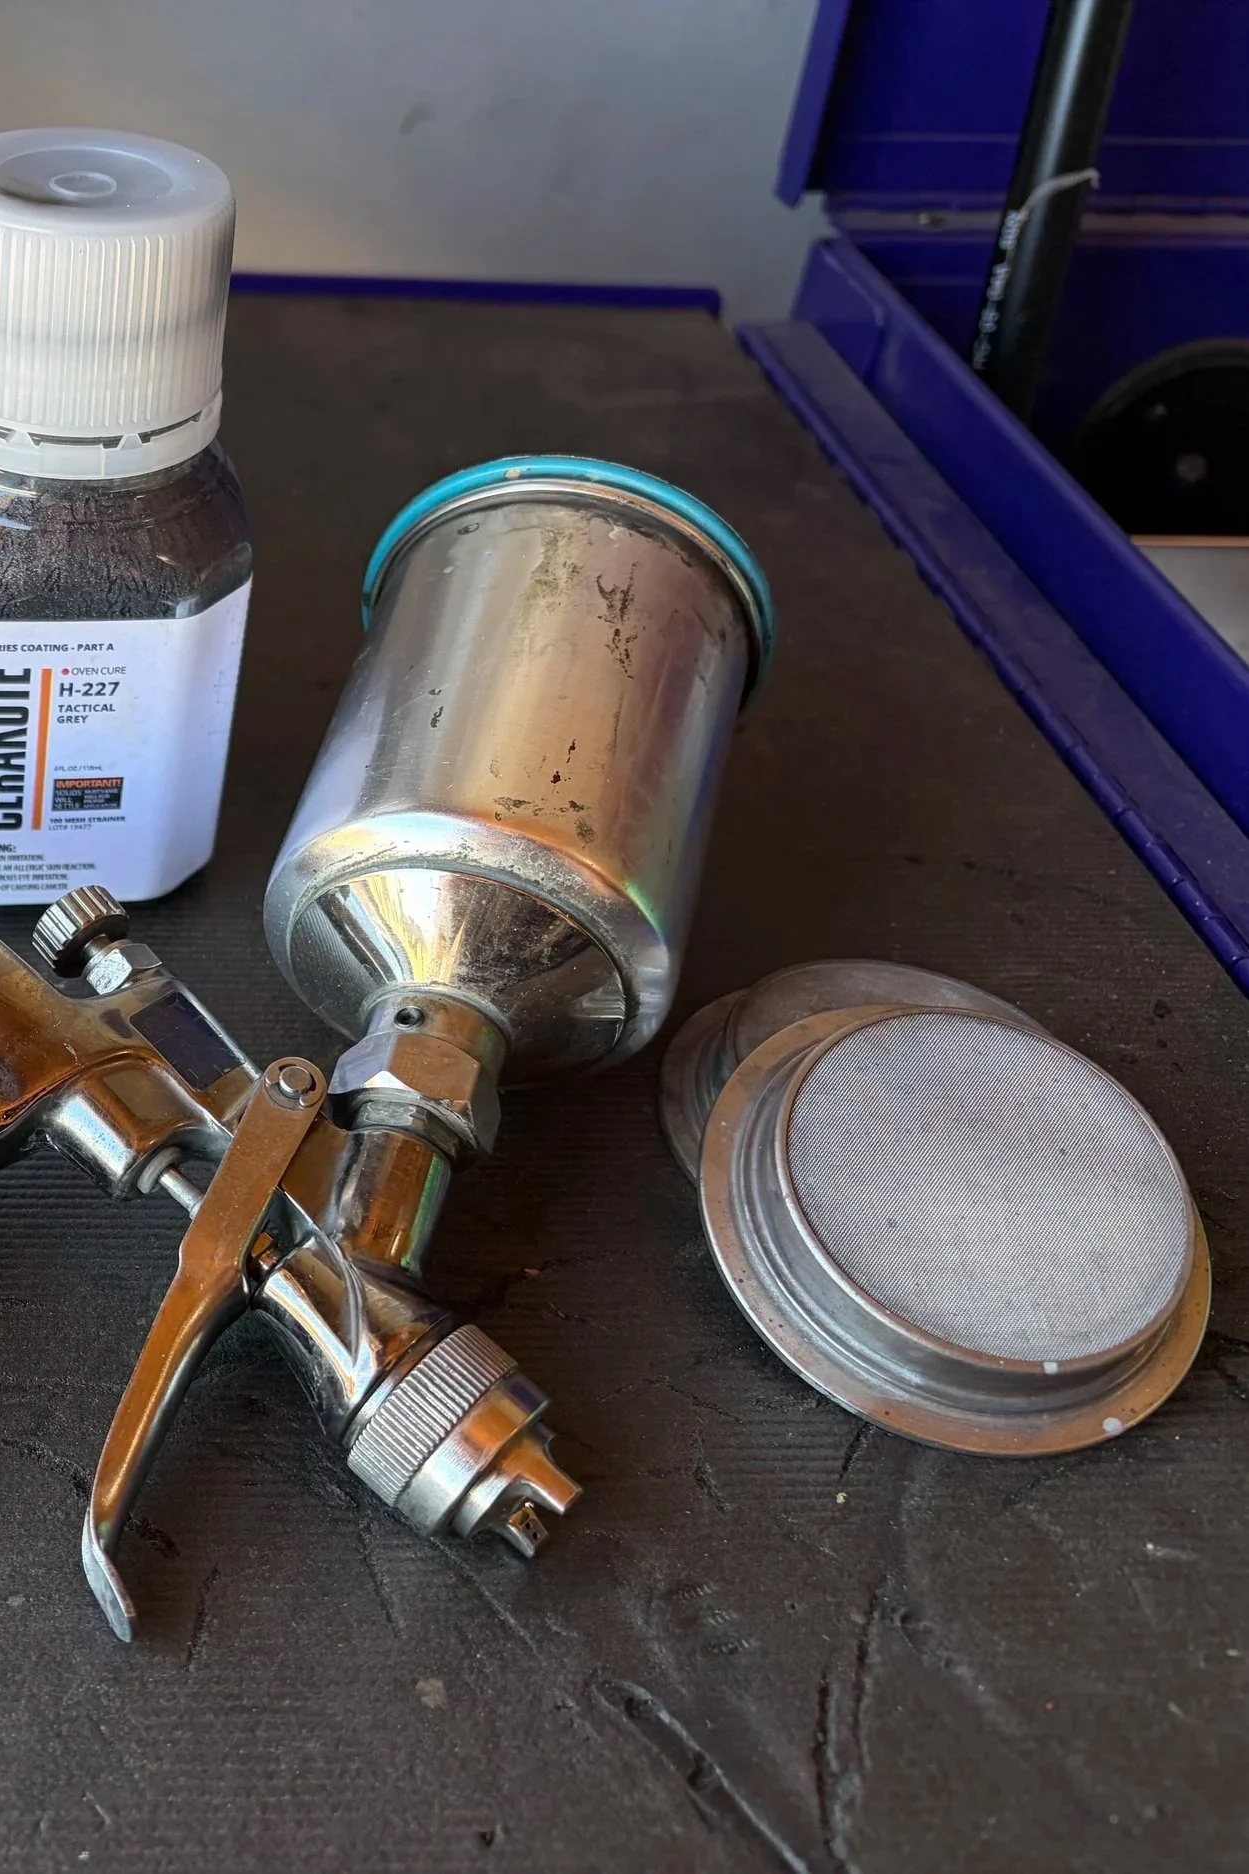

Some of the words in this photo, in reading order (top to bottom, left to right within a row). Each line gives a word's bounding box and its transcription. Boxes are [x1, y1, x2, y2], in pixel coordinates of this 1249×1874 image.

[21, 643, 69, 652] COATING
[77, 643, 104, 651] PART
[106, 643, 115, 651] A
[72, 667, 99, 676] OVEN
[100, 666, 127, 675] CURE
[58, 681, 121, 698] H-227
[57, 704, 116, 713] TACTICAL
[57, 715, 89, 724] GREY
[56, 779, 121, 788] IMPORTANT!
